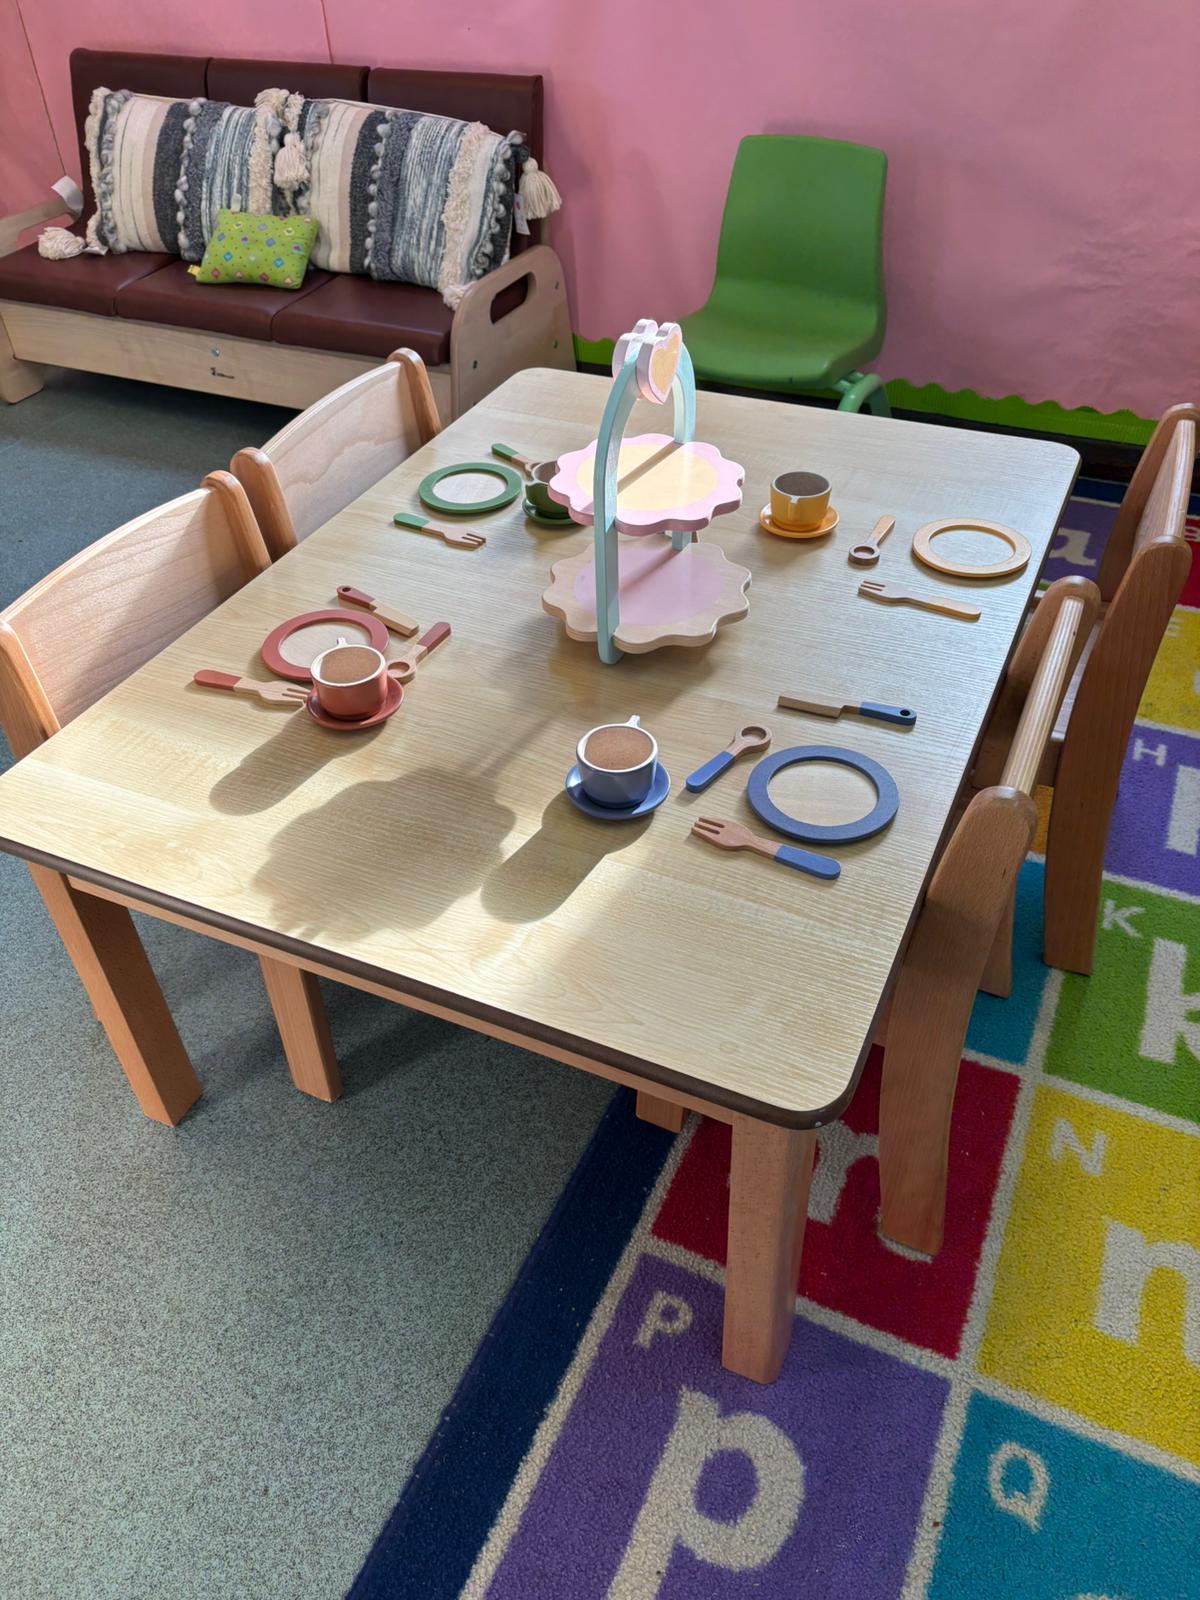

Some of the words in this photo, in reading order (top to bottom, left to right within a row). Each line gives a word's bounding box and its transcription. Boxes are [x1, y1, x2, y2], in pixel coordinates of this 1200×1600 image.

[1133, 738, 1168, 767] H
[1102, 899, 1146, 939] K
[1050, 1117, 1107, 1177] N
[1092, 1216, 1200, 1369] n
[606, 1384, 805, 1600] p
[987, 1440, 1050, 1534] Q
